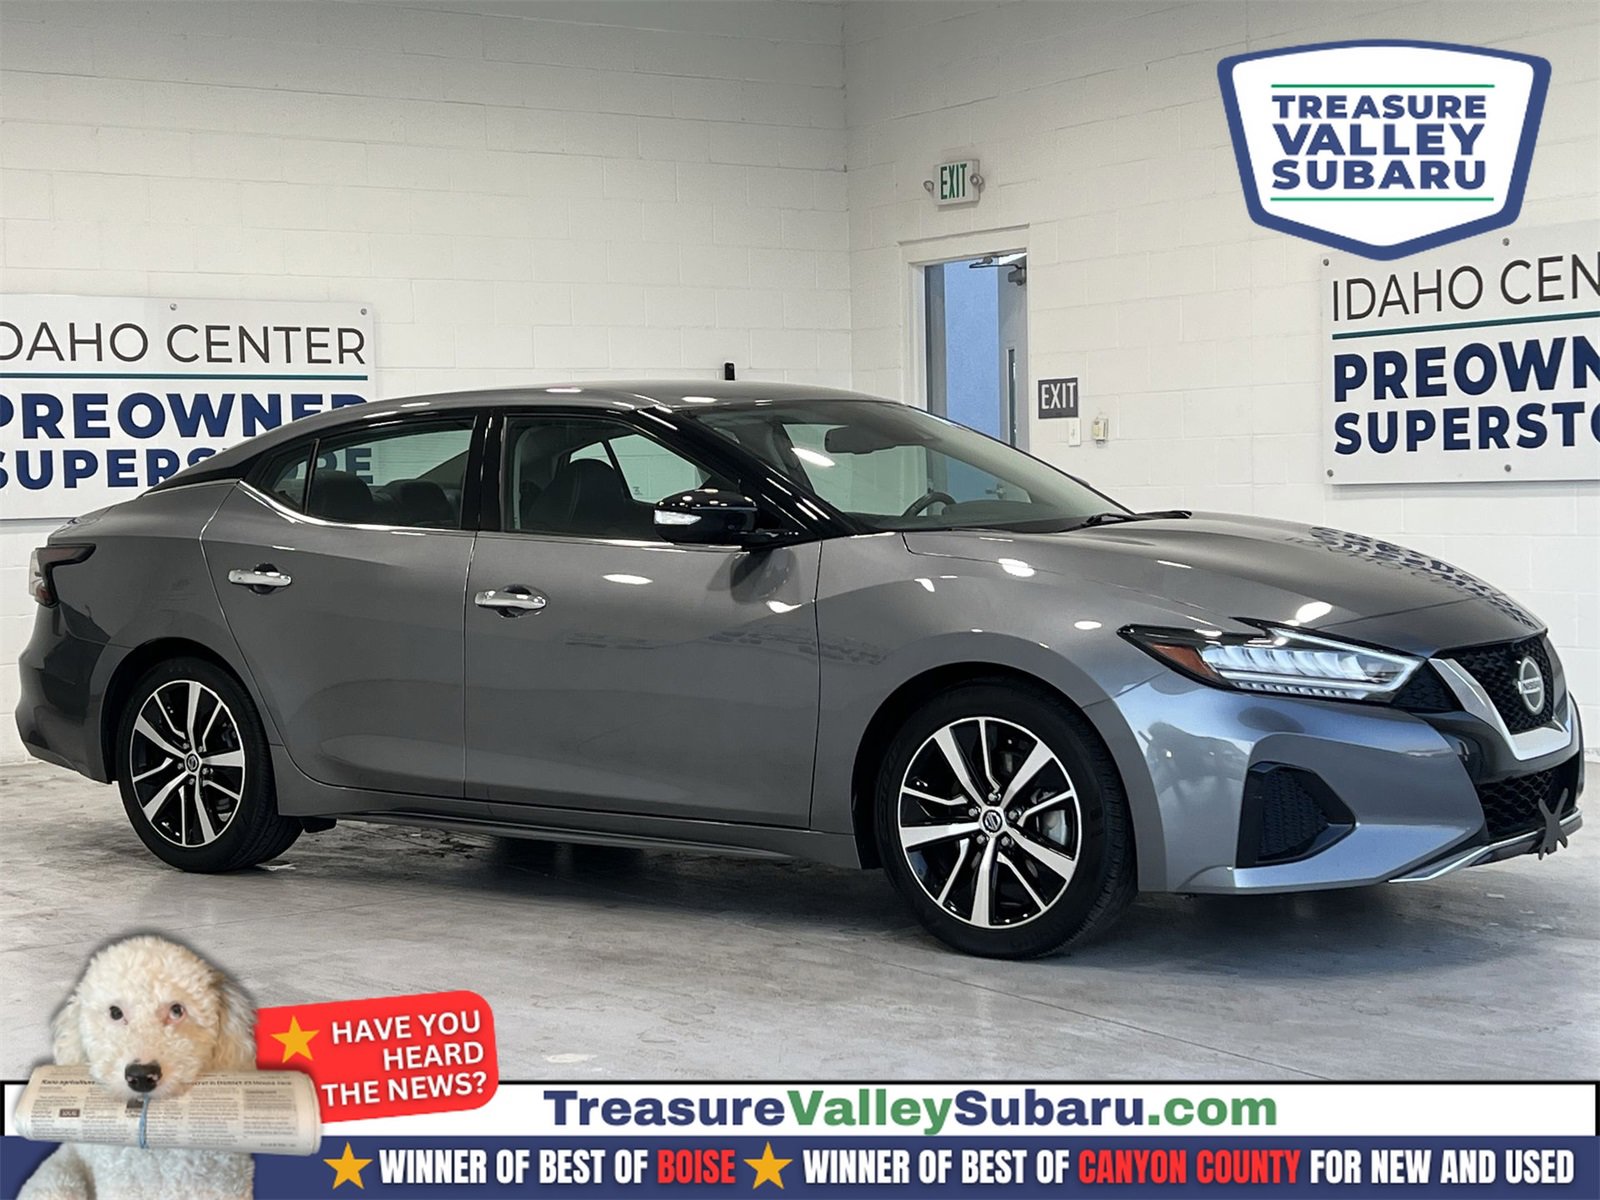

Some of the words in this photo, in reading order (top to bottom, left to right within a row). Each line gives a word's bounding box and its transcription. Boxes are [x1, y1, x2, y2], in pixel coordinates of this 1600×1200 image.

[939, 163, 968, 200] EXIT
[1333, 265, 1484, 322] IDAHO
[1500, 251, 1600, 305] CEN
[166, 323, 366, 365] CENTER
[1334, 335, 1600, 402] PREOWN
[0, 392, 367, 439] REOWN
[1040, 382, 1077, 410] EXIT
[1334, 401, 1600, 455] SUPERST
